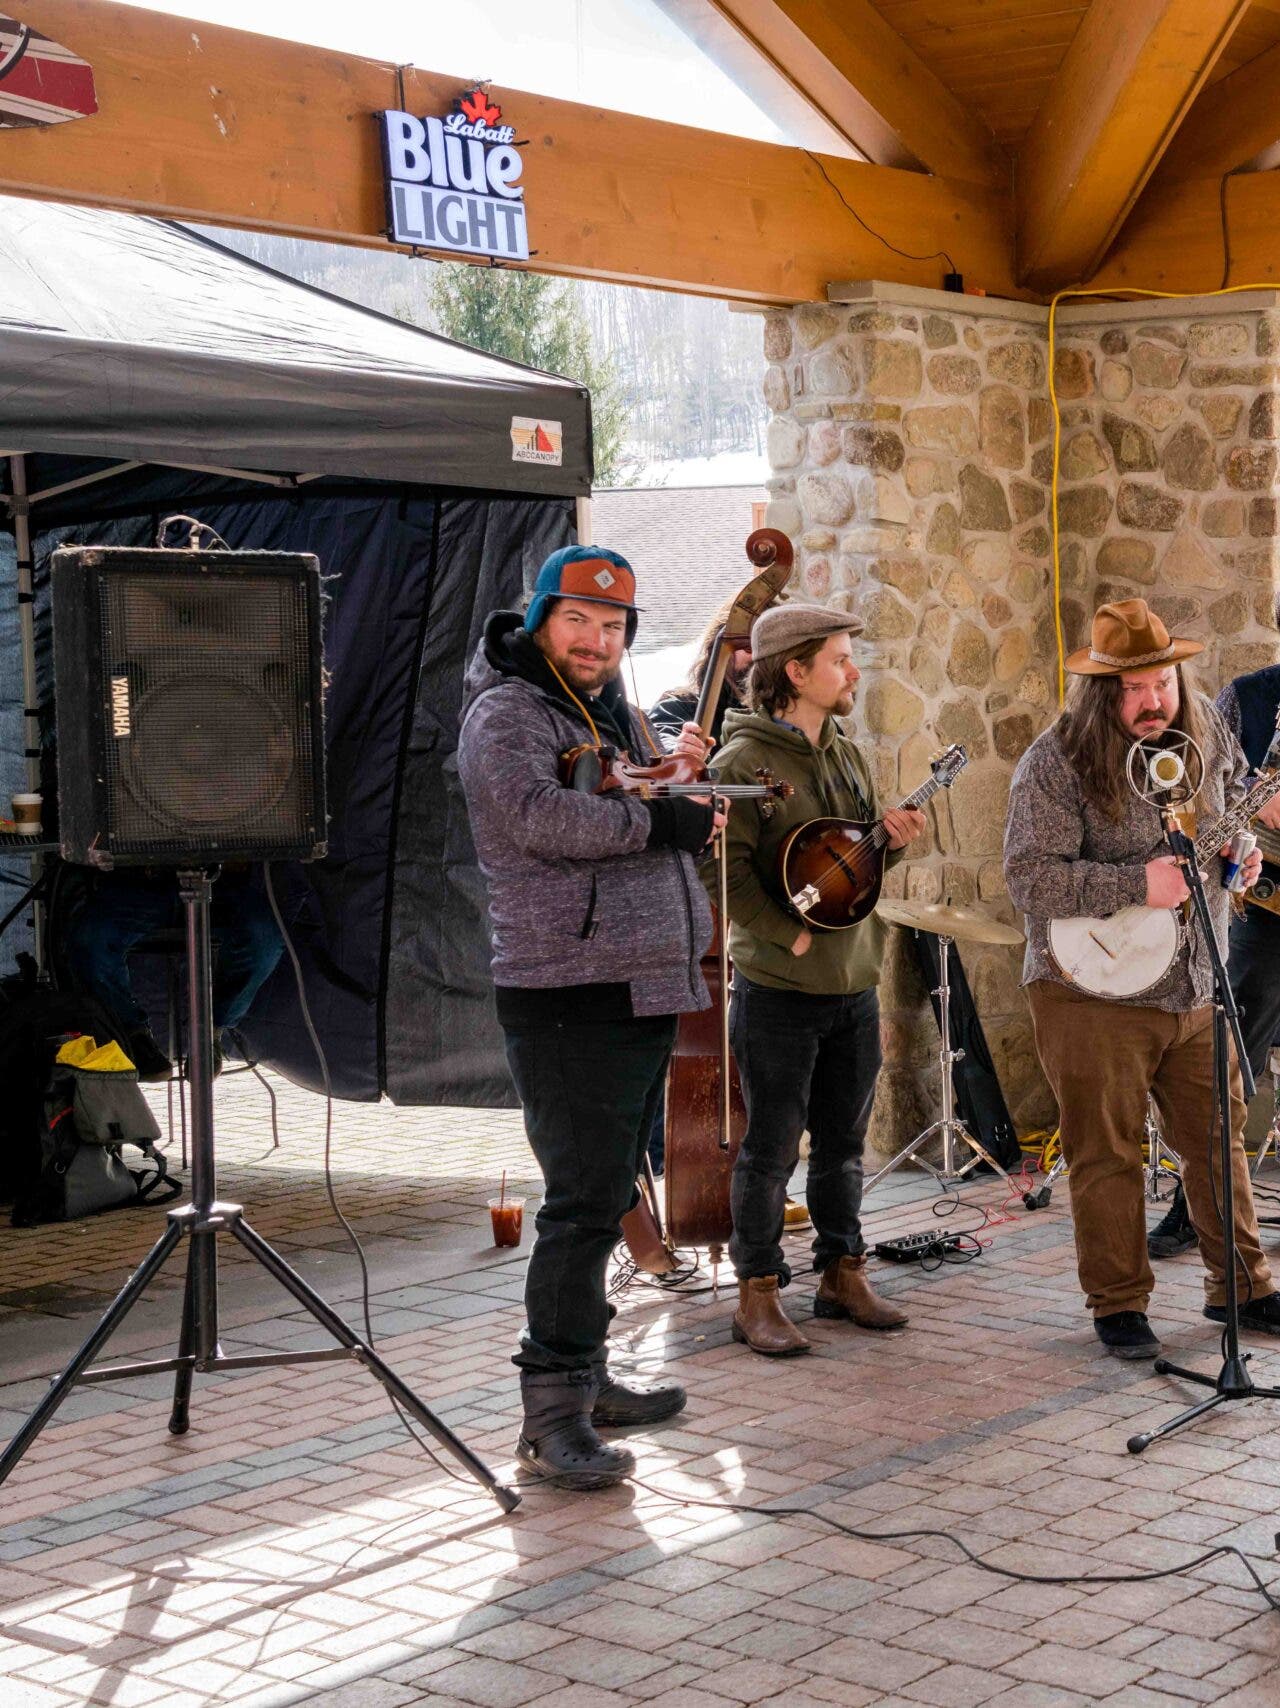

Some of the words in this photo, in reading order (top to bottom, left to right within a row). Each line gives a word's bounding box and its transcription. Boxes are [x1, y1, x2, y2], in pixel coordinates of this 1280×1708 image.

[385, 110, 524, 199] Blue
[444, 113, 515, 143] Labatt
[394, 186, 523, 253] LIGHT
[111, 677, 130, 736] YAMAHA
